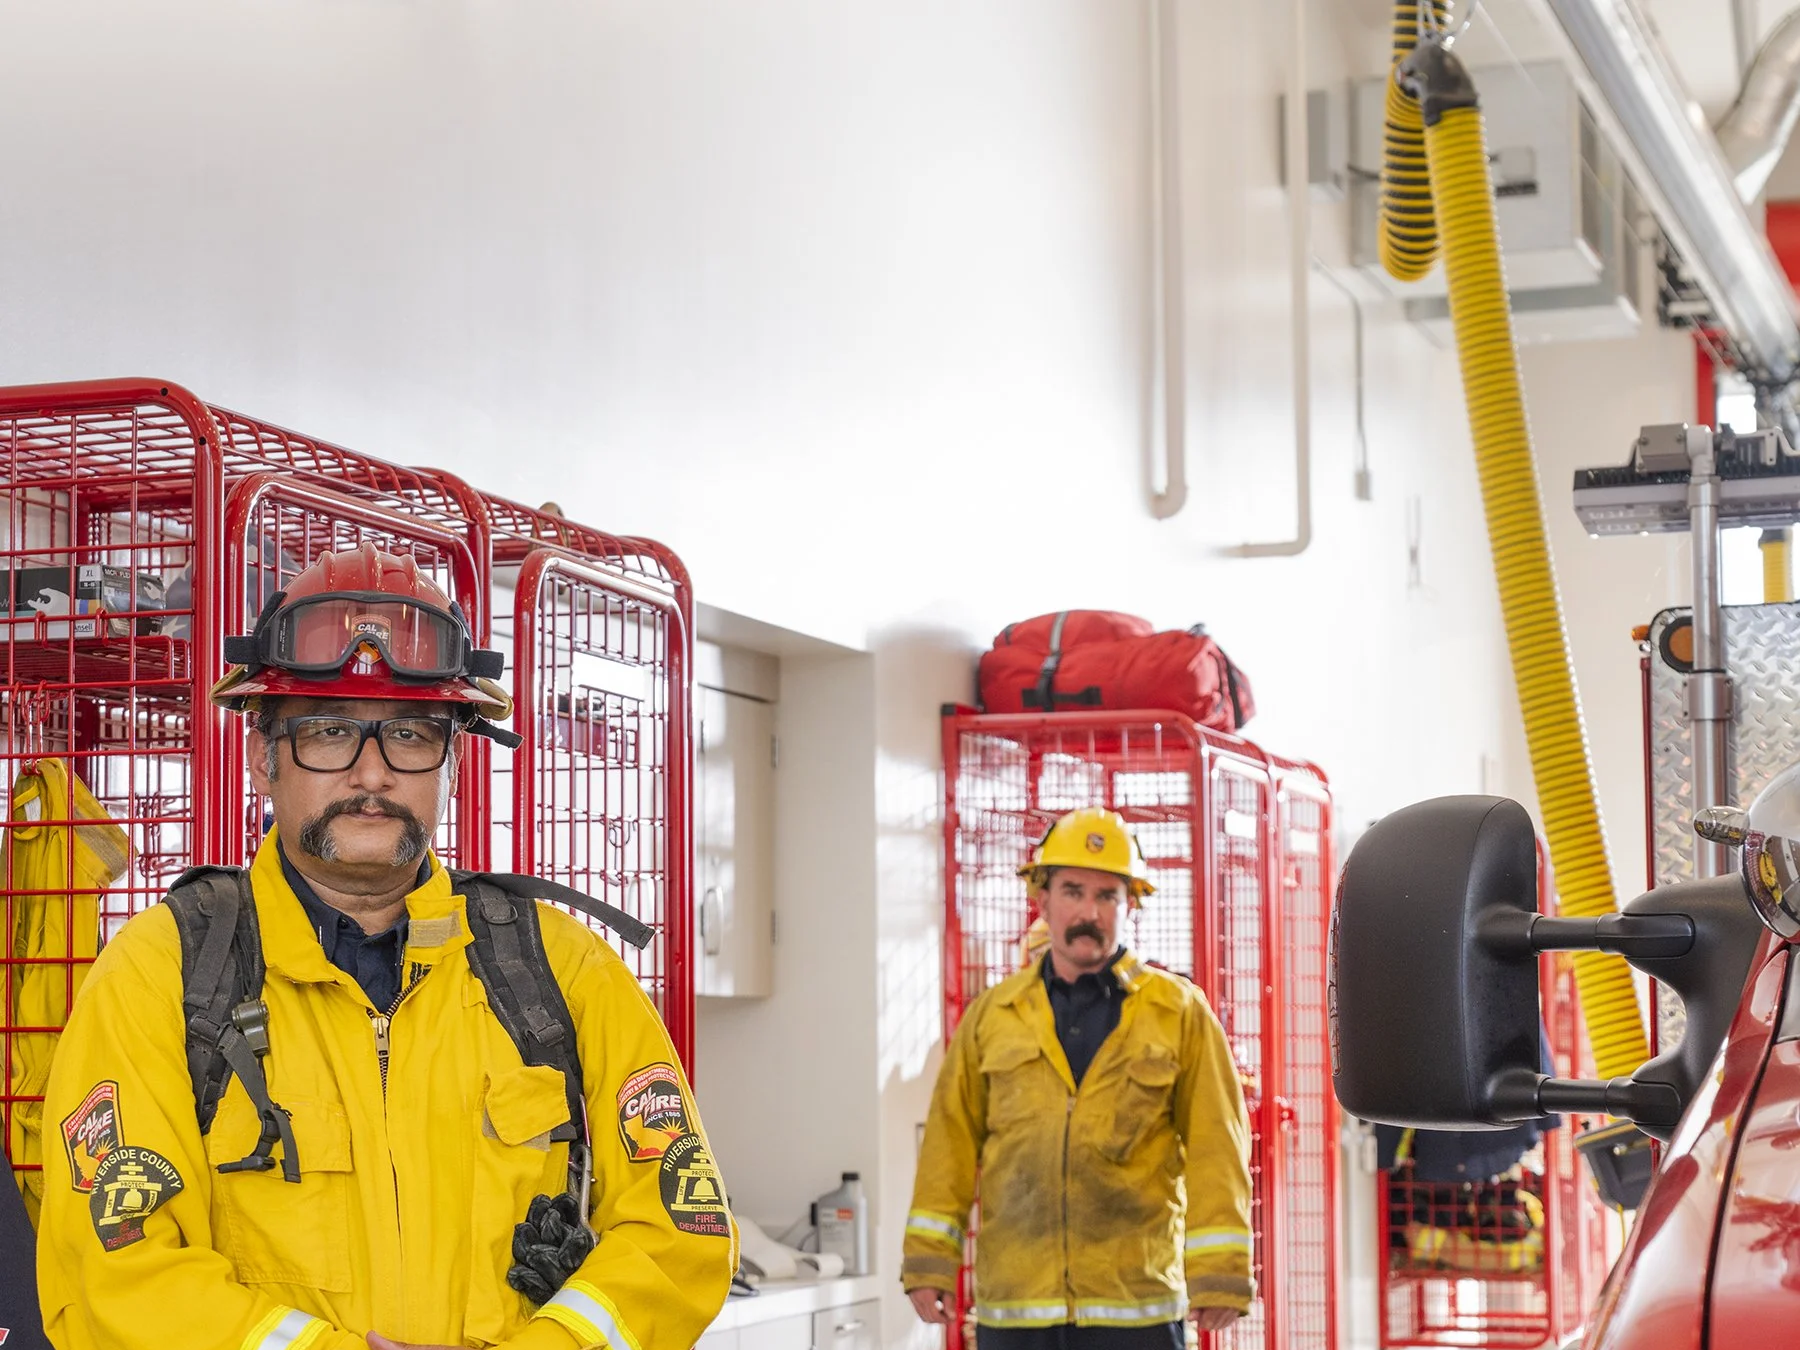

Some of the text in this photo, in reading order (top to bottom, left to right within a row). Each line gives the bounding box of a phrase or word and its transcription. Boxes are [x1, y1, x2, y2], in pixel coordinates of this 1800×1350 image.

[358, 624, 377, 632] CAL
[367, 630, 389, 640] RE
[626, 1087, 657, 1118] CAL
[644, 1094, 682, 1126] FIRE
[77, 1111, 98, 1142] CAL
[91, 1149, 182, 1195] RIVERSIDE COUNTY
[679, 1222, 730, 1234] DEPARTMEN
[695, 1214, 717, 1223] FIRE
